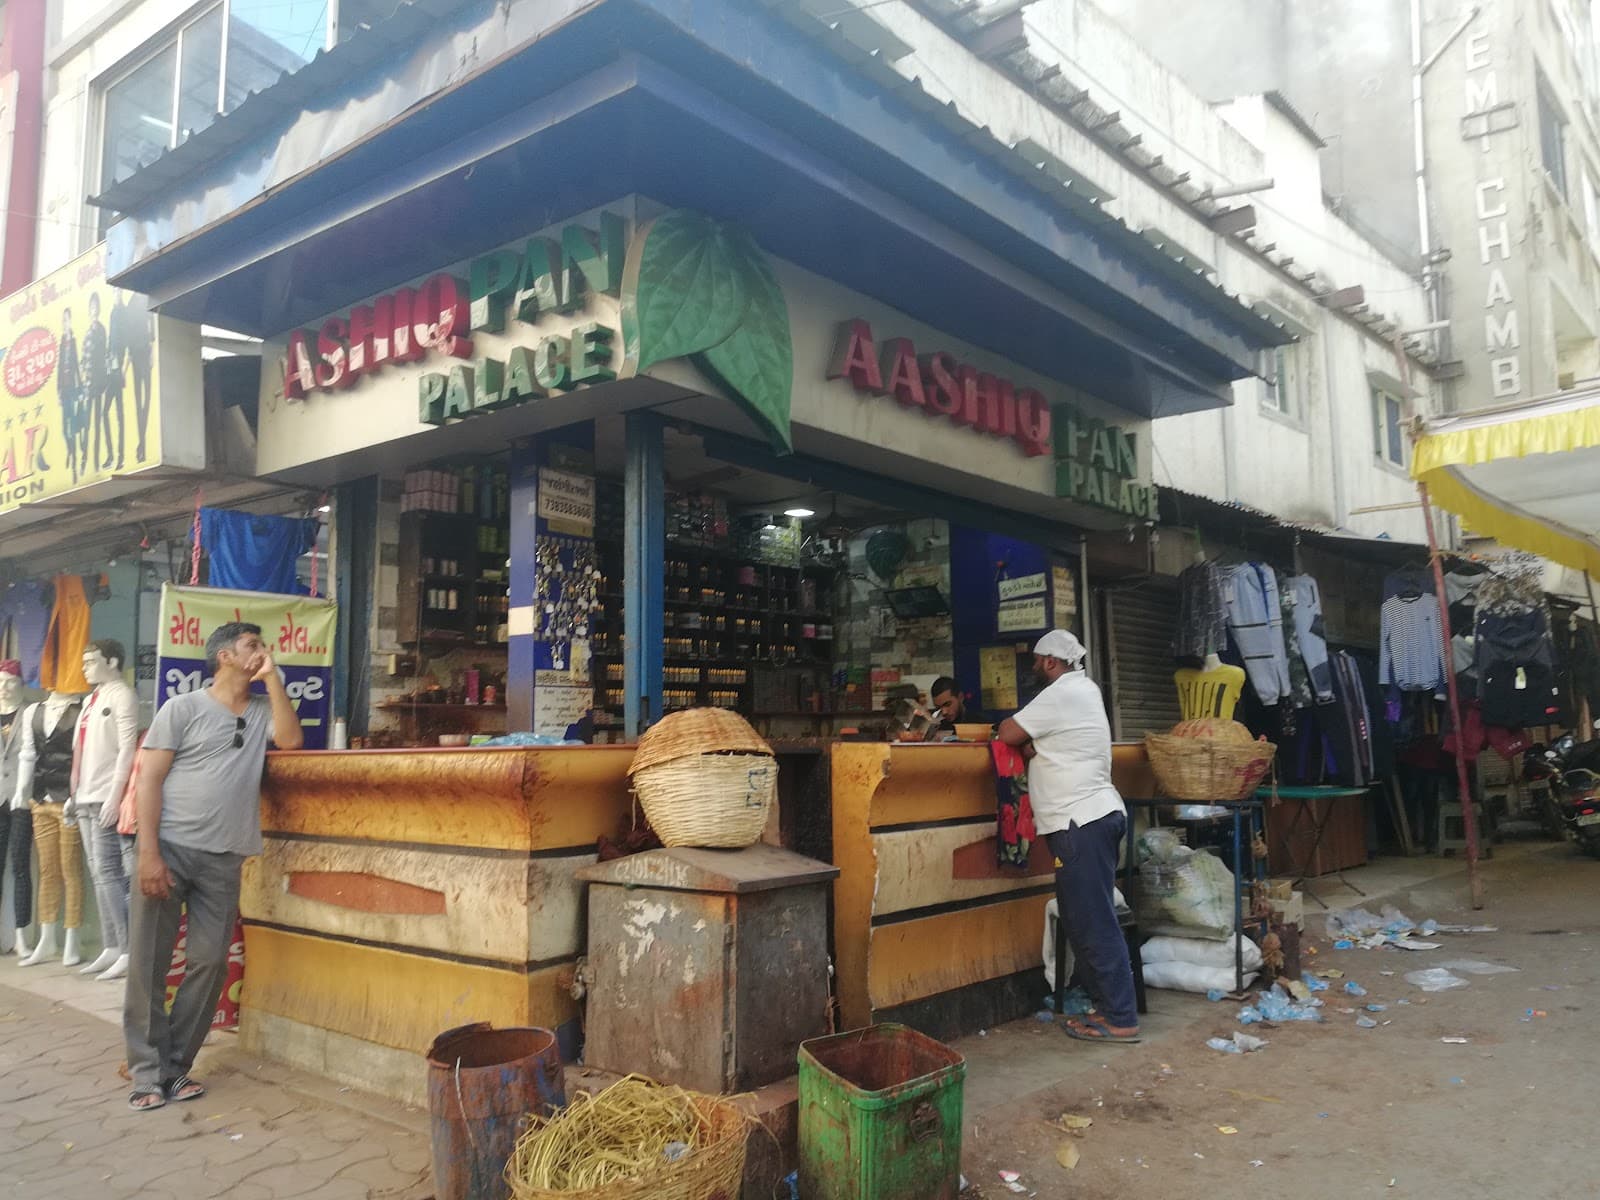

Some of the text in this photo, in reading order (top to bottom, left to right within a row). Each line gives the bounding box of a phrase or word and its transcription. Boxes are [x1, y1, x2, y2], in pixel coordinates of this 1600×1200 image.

[284, 210, 625, 403] ASHIQ PAN
[1475, 177, 1521, 397] CHAMB
[418, 322, 617, 424] PALACE
[826, 318, 1138, 480] AASHIQ PAN
[1056, 460, 1161, 522] PALACE
